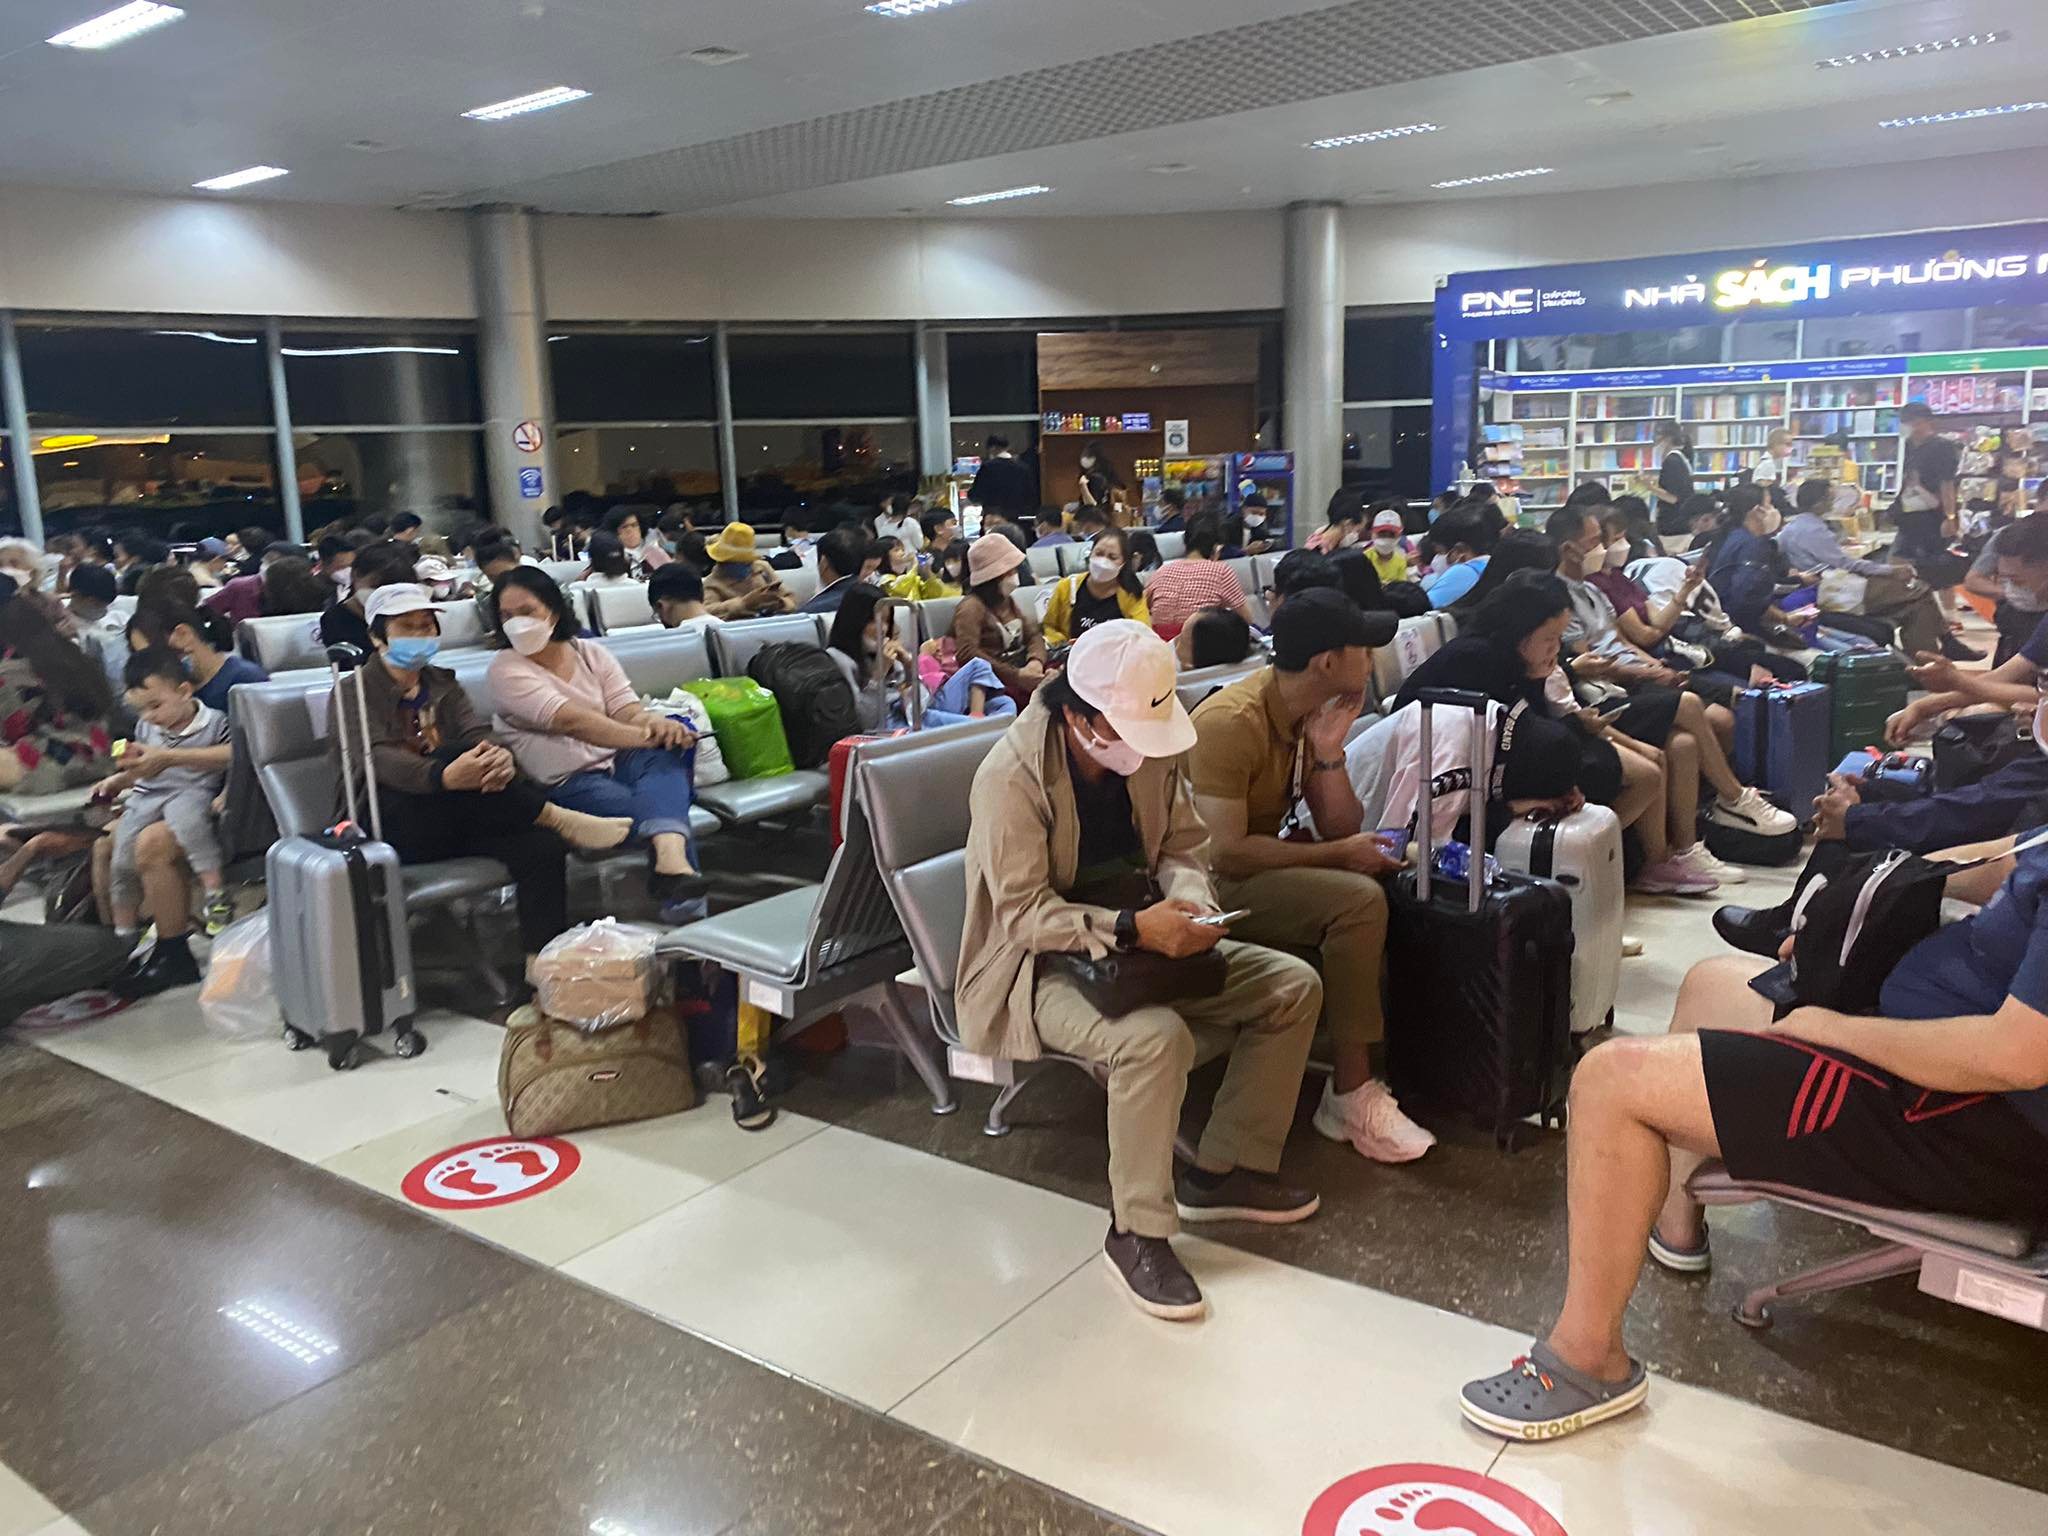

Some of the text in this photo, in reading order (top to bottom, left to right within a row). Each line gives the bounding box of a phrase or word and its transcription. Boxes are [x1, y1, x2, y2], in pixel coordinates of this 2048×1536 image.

[1462, 288, 1533, 311] PNC
[1624, 274, 1705, 308] NHÀ
[1714, 258, 1831, 307] SÁCH
[1840, 256, 2028, 289] PHƯƠNG
